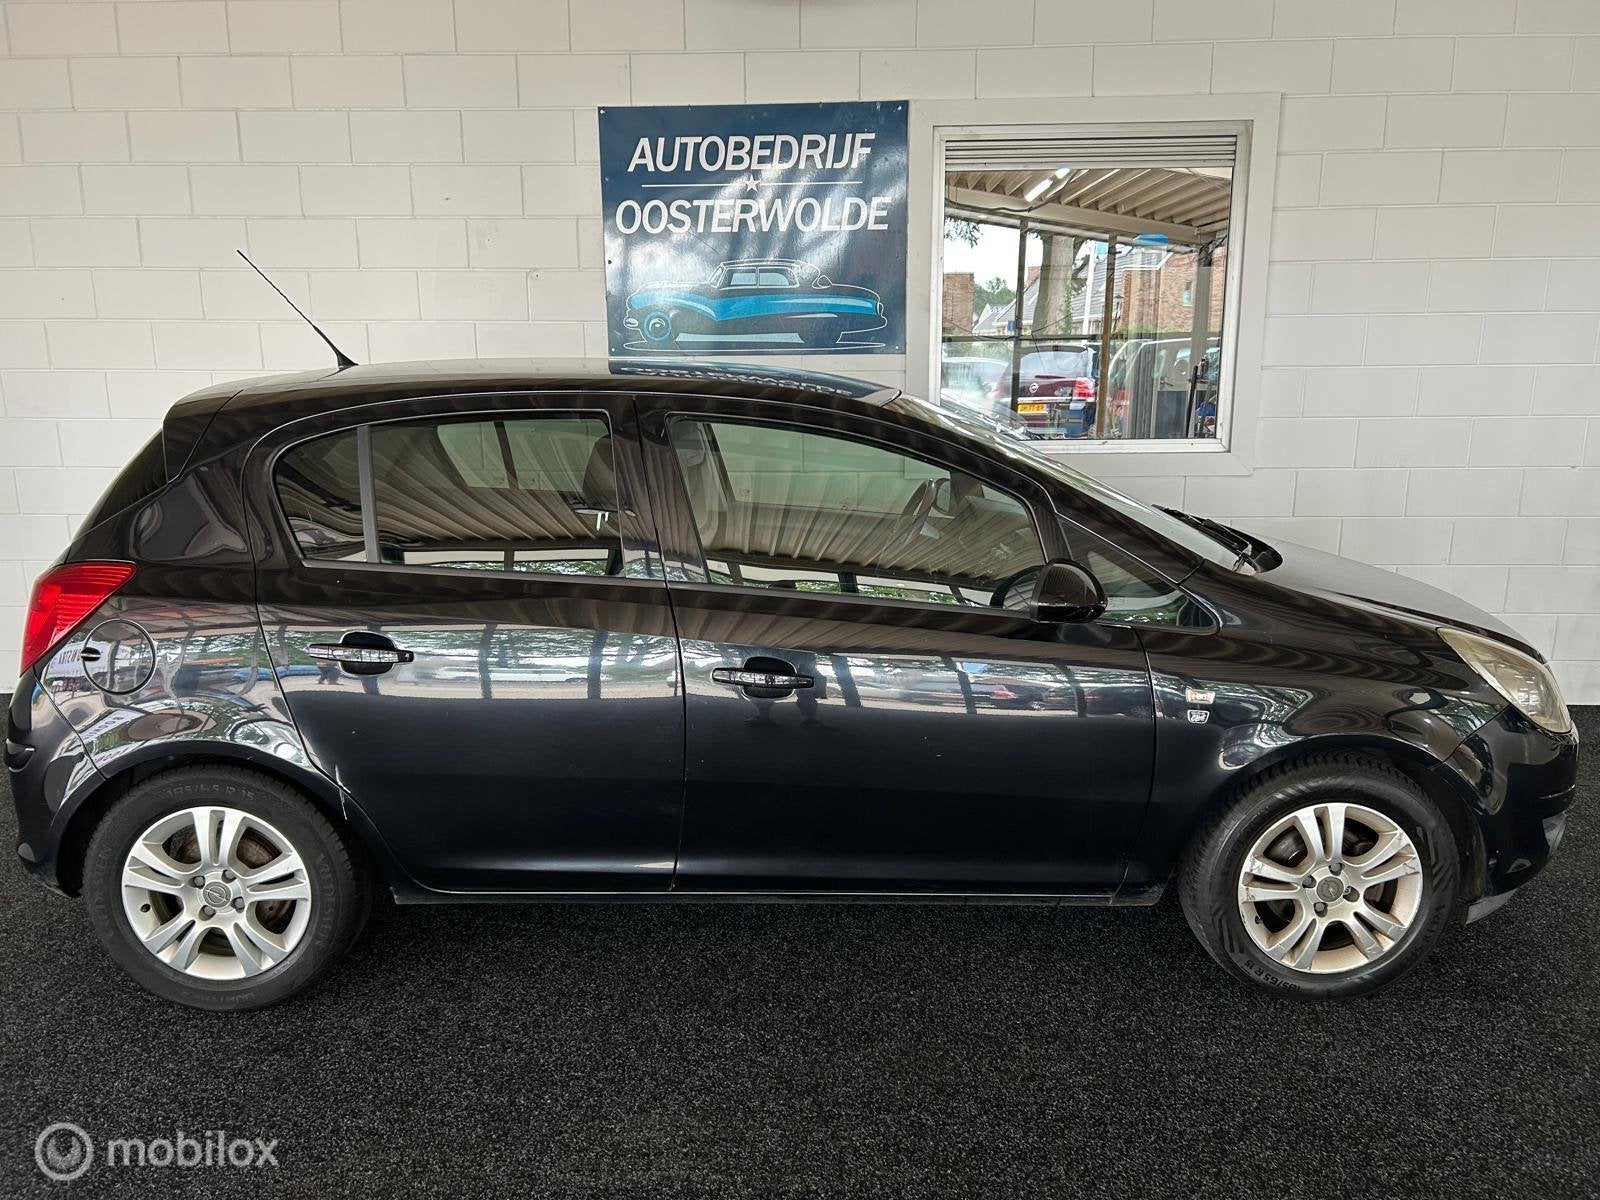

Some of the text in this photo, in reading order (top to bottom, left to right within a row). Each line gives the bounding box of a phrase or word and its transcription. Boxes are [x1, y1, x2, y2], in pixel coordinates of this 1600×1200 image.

[628, 132, 875, 172] AUTOBEDRIJF
[615, 196, 892, 234] OOSTERWOLDE
[1243, 959, 1256, 970] 15
[1263, 973, 1302, 993] 185/65
